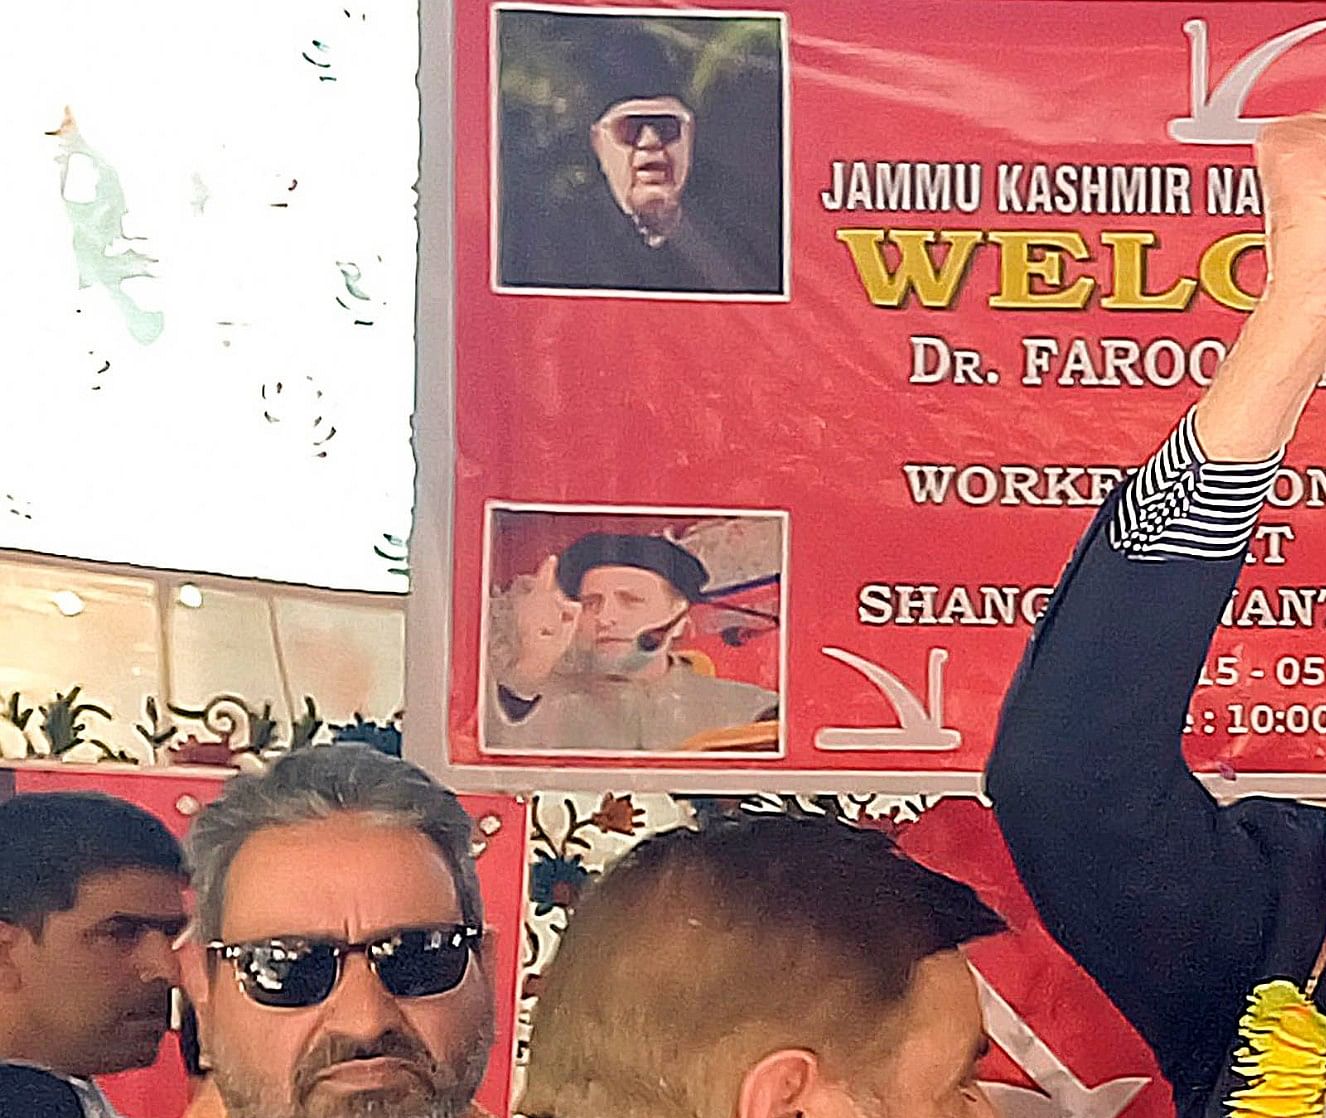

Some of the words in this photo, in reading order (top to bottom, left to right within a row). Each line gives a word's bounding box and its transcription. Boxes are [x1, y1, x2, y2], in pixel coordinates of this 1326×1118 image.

[822, 160, 982, 214] JAMMU
[997, 162, 1192, 216] KASHMIR
[1021, 337, 1229, 388] FAROO
[903, 463, 1138, 506] WORKE
[857, 584, 1057, 626] SHANG
[1275, 655, 1326, 687] 05
